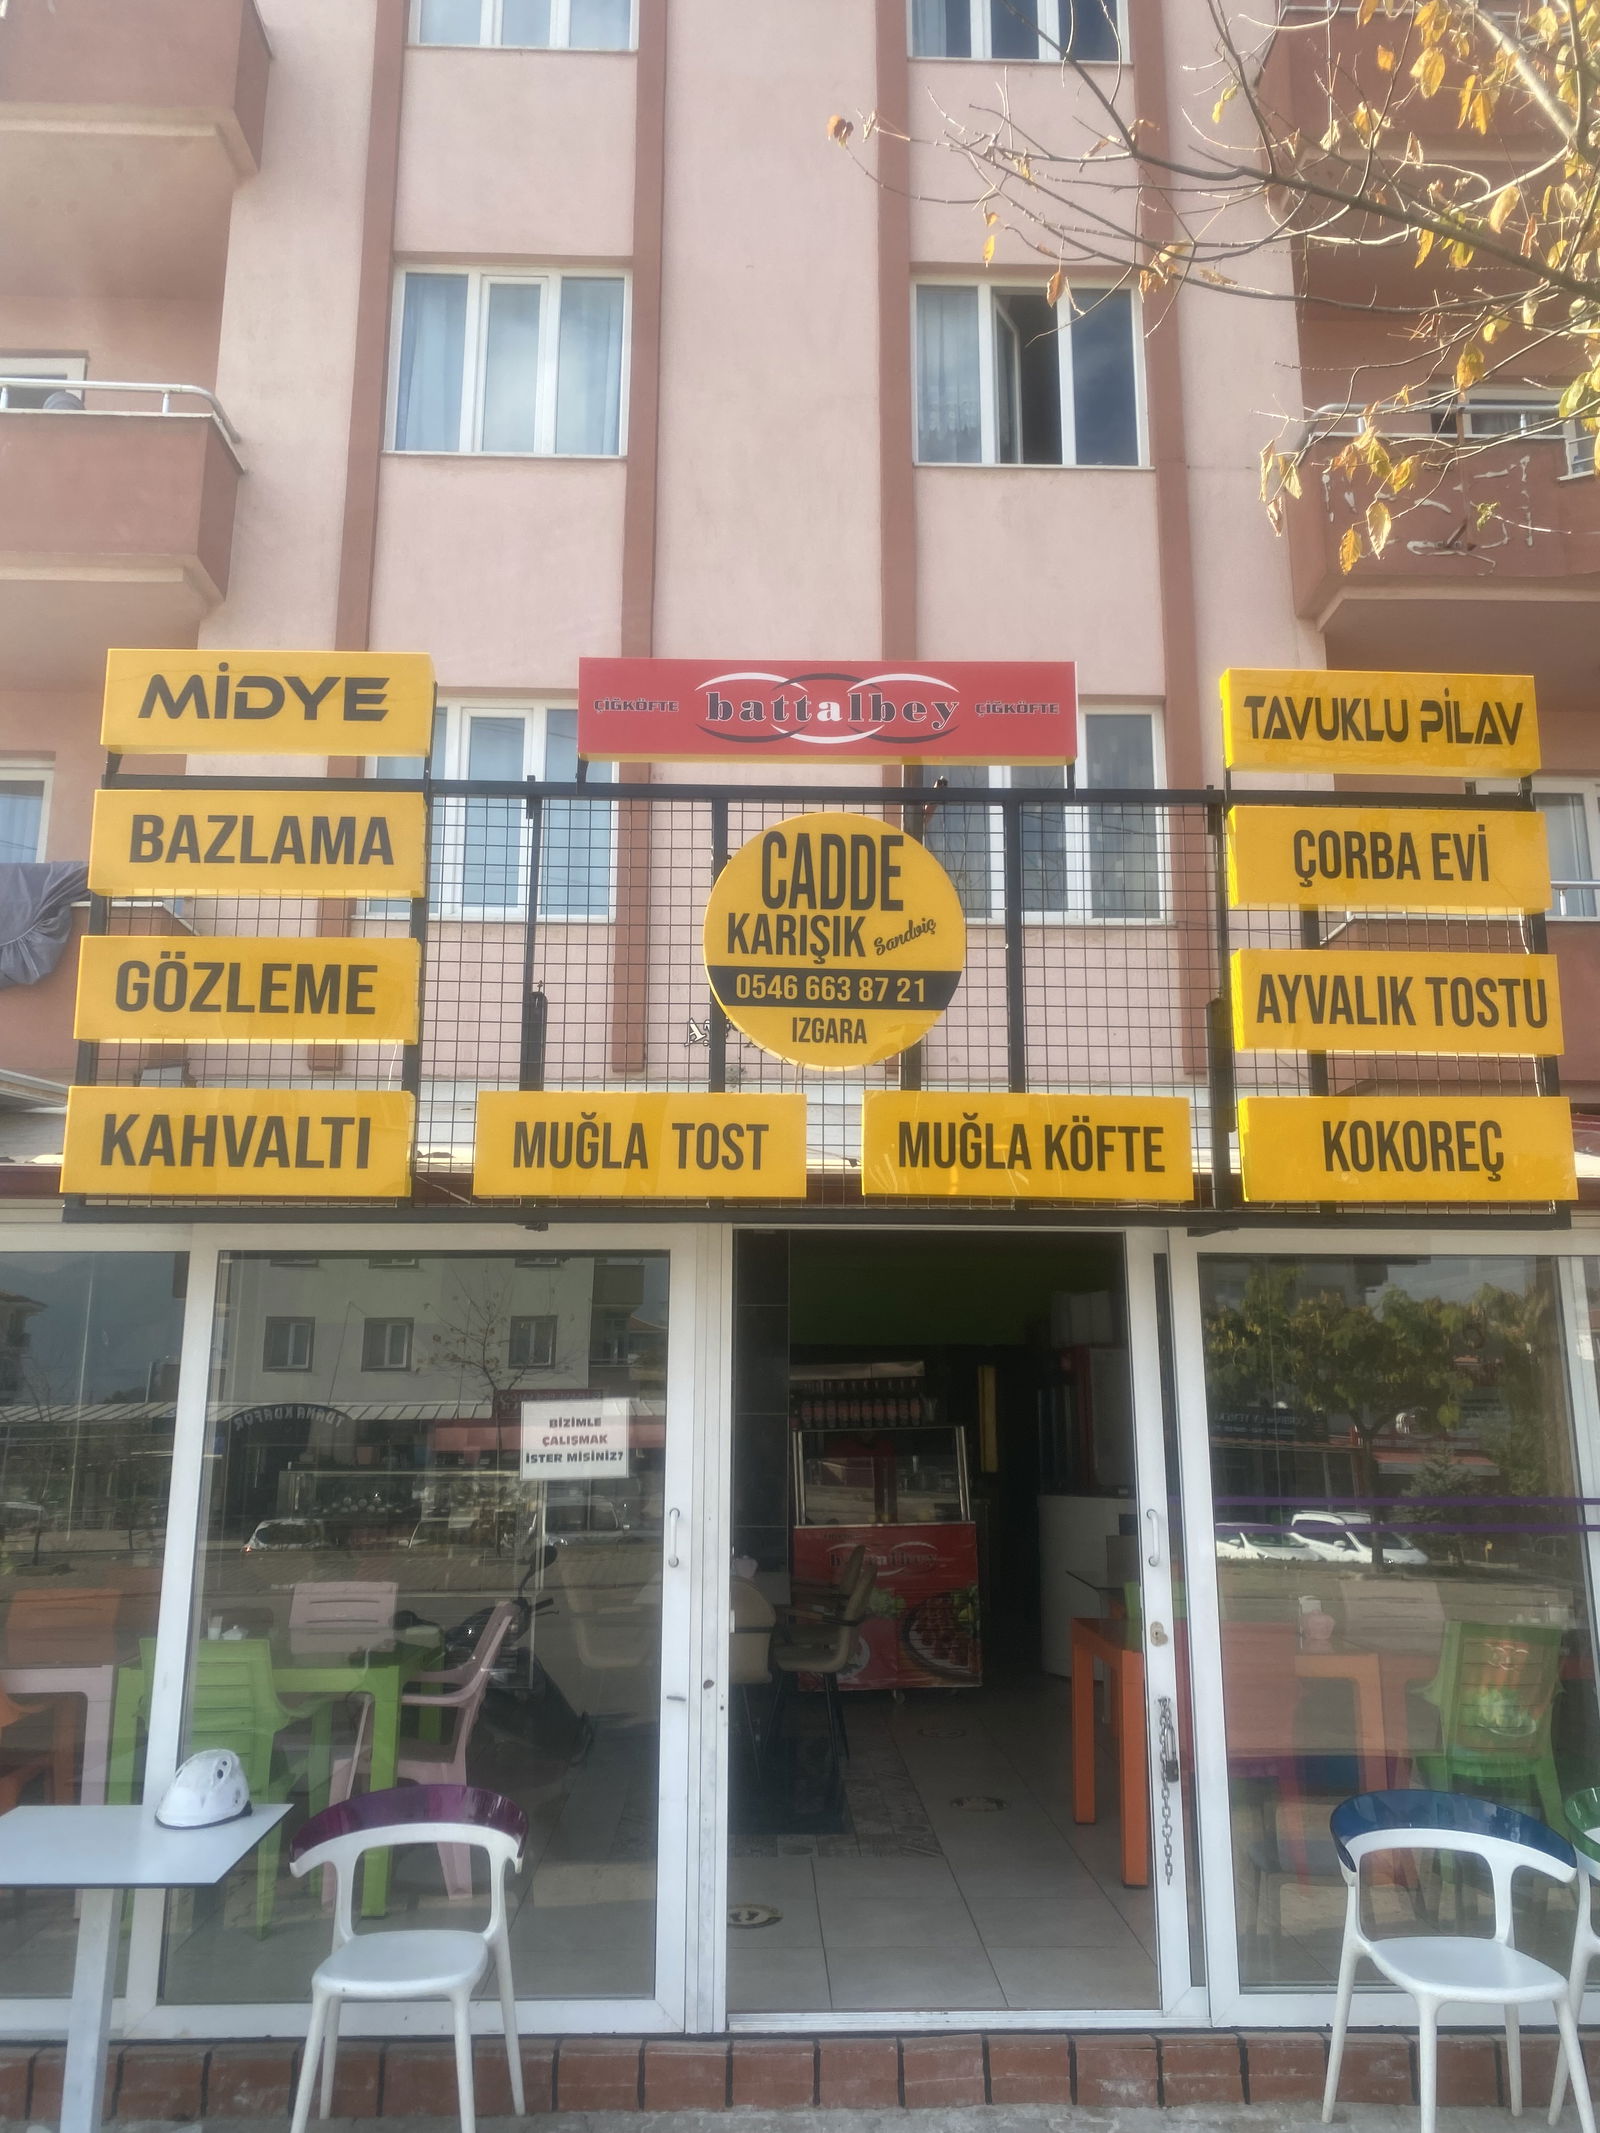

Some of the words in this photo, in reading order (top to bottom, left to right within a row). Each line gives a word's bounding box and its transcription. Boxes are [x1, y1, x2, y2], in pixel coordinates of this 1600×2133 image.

[138, 662, 391, 722] MİDYE
[593, 697, 680, 714] ÇİĞKÖFTE
[705, 691, 960, 731] battalbey
[975, 699, 1060, 717] ÇİĞKÖFTE
[1243, 695, 1409, 743] TAVUKLU
[1421, 687, 1524, 746] PİLAV
[129, 814, 394, 866] BAZLAMA
[1293, 829, 1422, 888] ÇORBA
[1432, 824, 1490, 882] EVİ
[761, 830, 905, 912] CADDE
[727, 912, 867, 965] KARIŞIK
[873, 917, 937, 956] Sandviç
[115, 951, 379, 1016] GÖZLEME
[735, 973, 798, 1000] 0546
[805, 975, 851, 1001] 663
[858, 977, 889, 1002] 87
[896, 977, 926, 1003] 21
[1256, 973, 1416, 1027] AYVALIK
[1426, 976, 1548, 1029] TOSTU
[791, 1016, 868, 1044] IZGARA
[100, 1113, 371, 1169] KAHVALTI
[513, 1111, 649, 1169] MUĞLA
[672, 1122, 769, 1171] TOST
[899, 1111, 1032, 1170] MUĞLA
[1044, 1115, 1166, 1173] KÖFTE
[1322, 1119, 1505, 1182] KOKOREÇ
[542, 1434, 608, 1448] ÇALIŞMAK
[549, 1416, 602, 1429] BİZİMLE
[525, 1451, 563, 1464] İSTER
